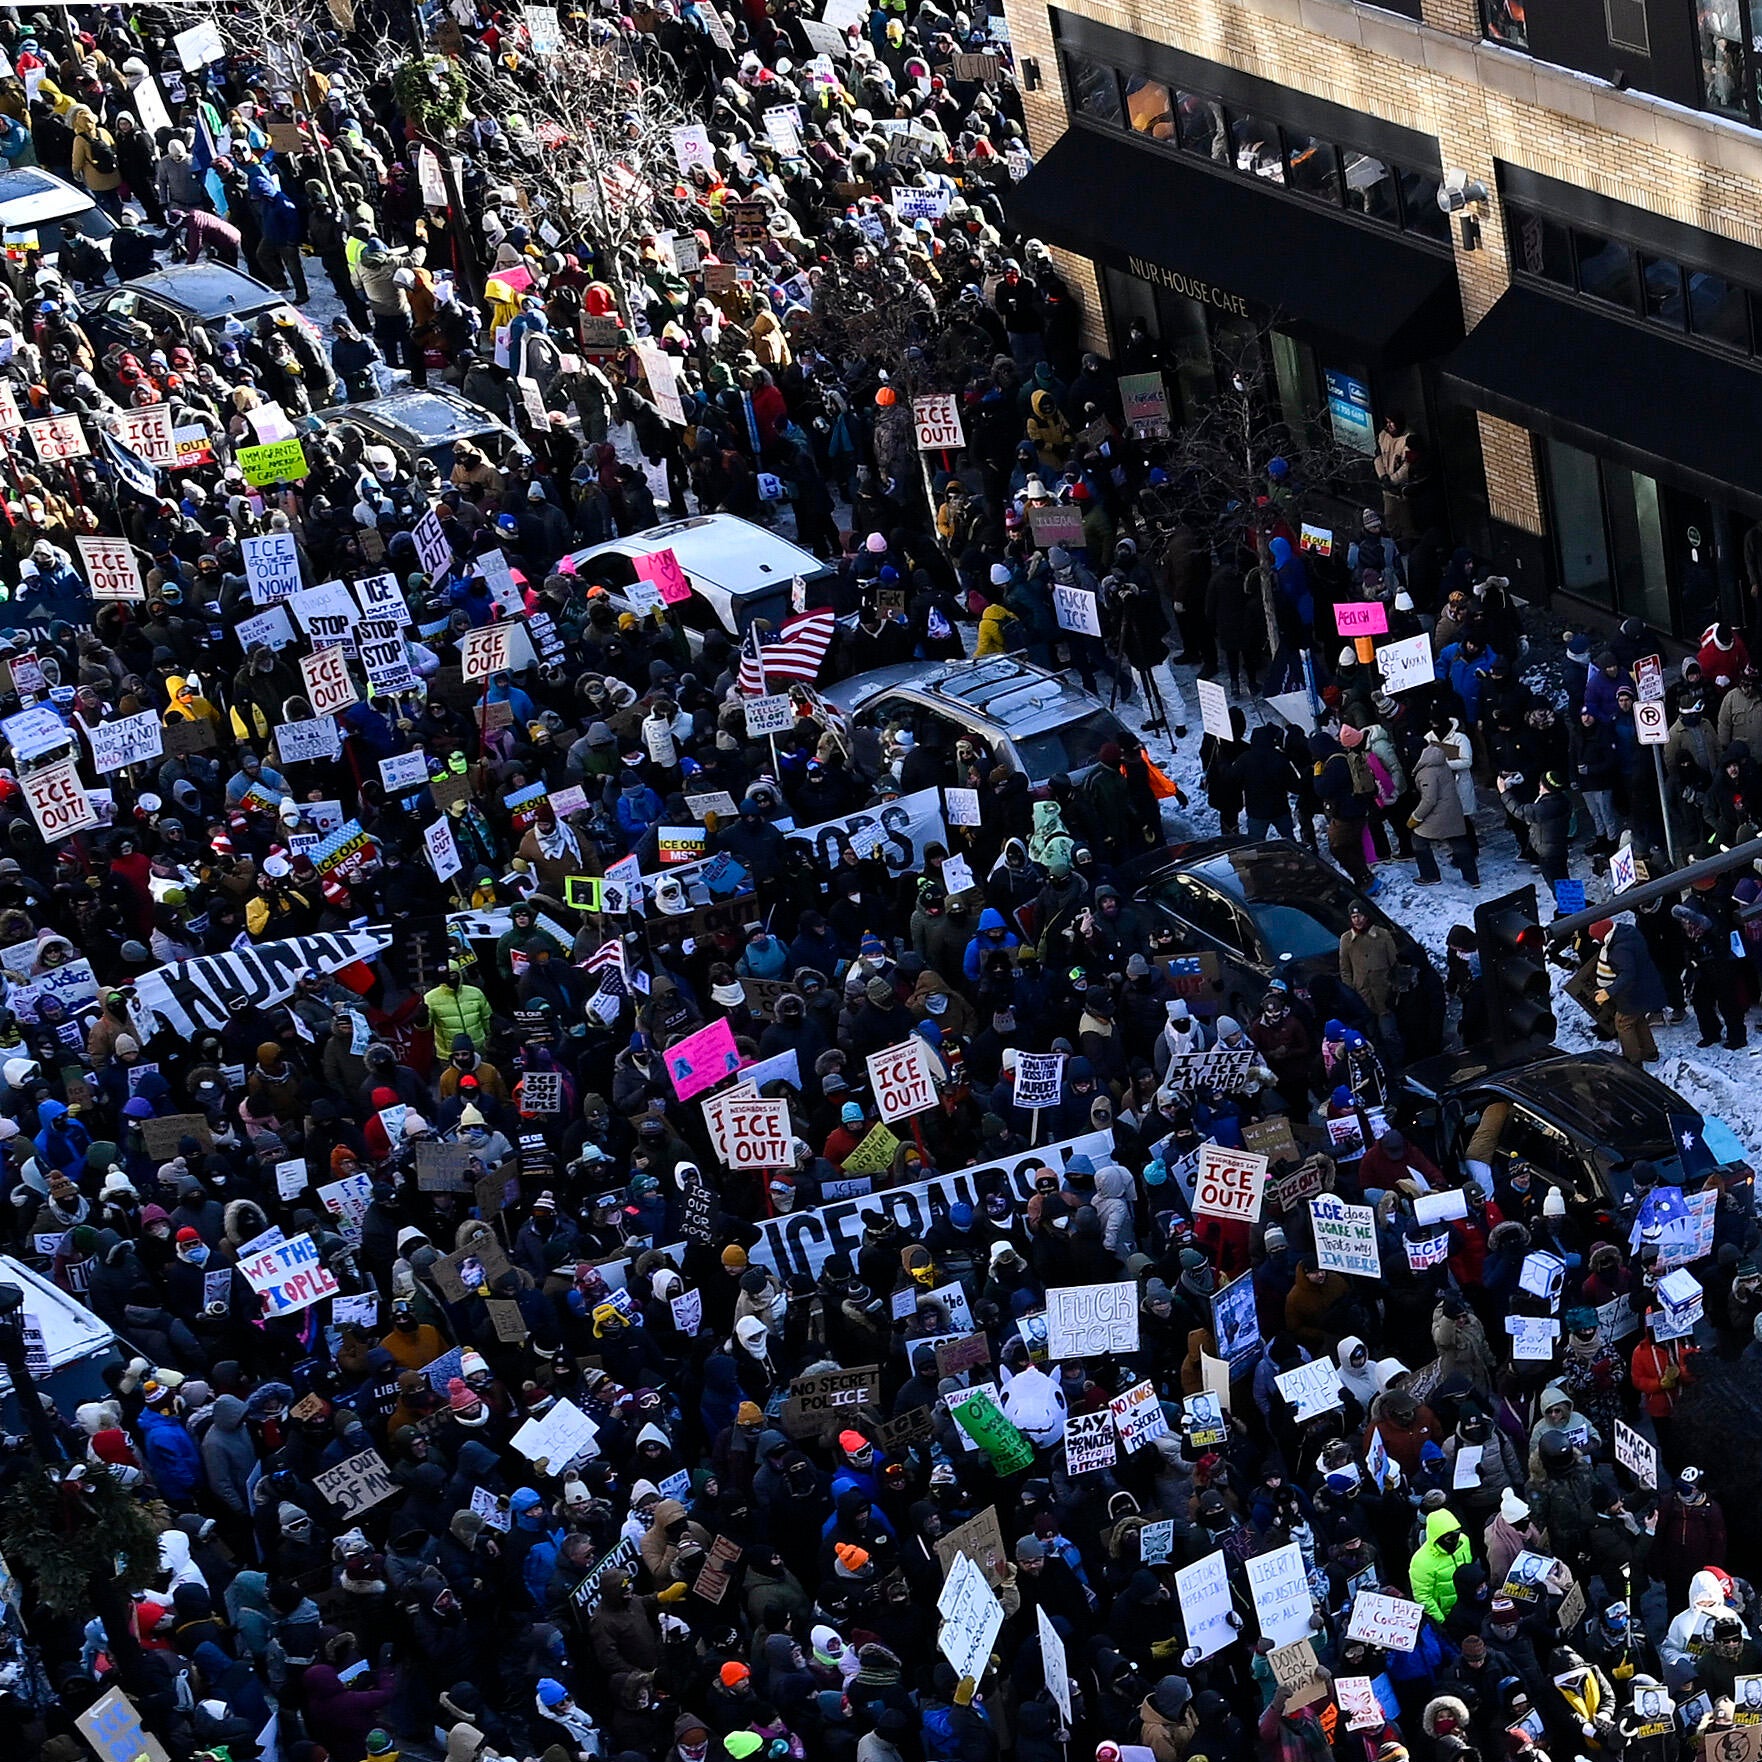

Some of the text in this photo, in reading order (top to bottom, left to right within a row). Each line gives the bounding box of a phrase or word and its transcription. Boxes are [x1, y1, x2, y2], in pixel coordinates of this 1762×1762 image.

[915, 407, 953, 425] ICE
[128, 418, 165, 440] ICE
[920, 426, 957, 445] OUT!
[249, 540, 285, 558] ICE
[88, 551, 129, 572] ICE
[256, 563, 288, 578] OUT
[94, 572, 135, 590] OUT!
[258, 576, 300, 596] NOW!
[363, 577, 393, 603] ICE
[1059, 592, 1090, 614] FUCK
[311, 615, 349, 635] STOP
[1064, 608, 1088, 629] ICE
[362, 640, 401, 668] STOP
[468, 633, 503, 654] ICE
[466, 652, 504, 674] OUT!
[308, 667, 332, 687] ICE
[314, 680, 348, 708] OUT!
[33, 779, 76, 807] ICE
[42, 799, 85, 829] OUT!
[878, 1062, 921, 1089] ICE
[1021, 1060, 1058, 1070] JONATHAN
[880, 1083, 930, 1112] OUT!
[1016, 1091, 1058, 1103] NOW!
[1020, 1080, 1060, 1093] MURDER
[733, 1115, 781, 1138] ICE
[736, 1140, 787, 1162] OUT!
[1202, 1163, 1253, 1191] ICE
[1202, 1184, 1255, 1214] OUT!
[277, 1237, 319, 1268] THE
[247, 1261, 278, 1280] WE
[261, 1265, 336, 1312] PEOPLE
[1059, 1288, 1132, 1324] FUCK
[1064, 1326, 1133, 1354] ICE
[791, 1371, 879, 1397] NO SECRET
[1067, 1414, 1108, 1436] SAY
[1616, 1422, 1652, 1463] MAGA
